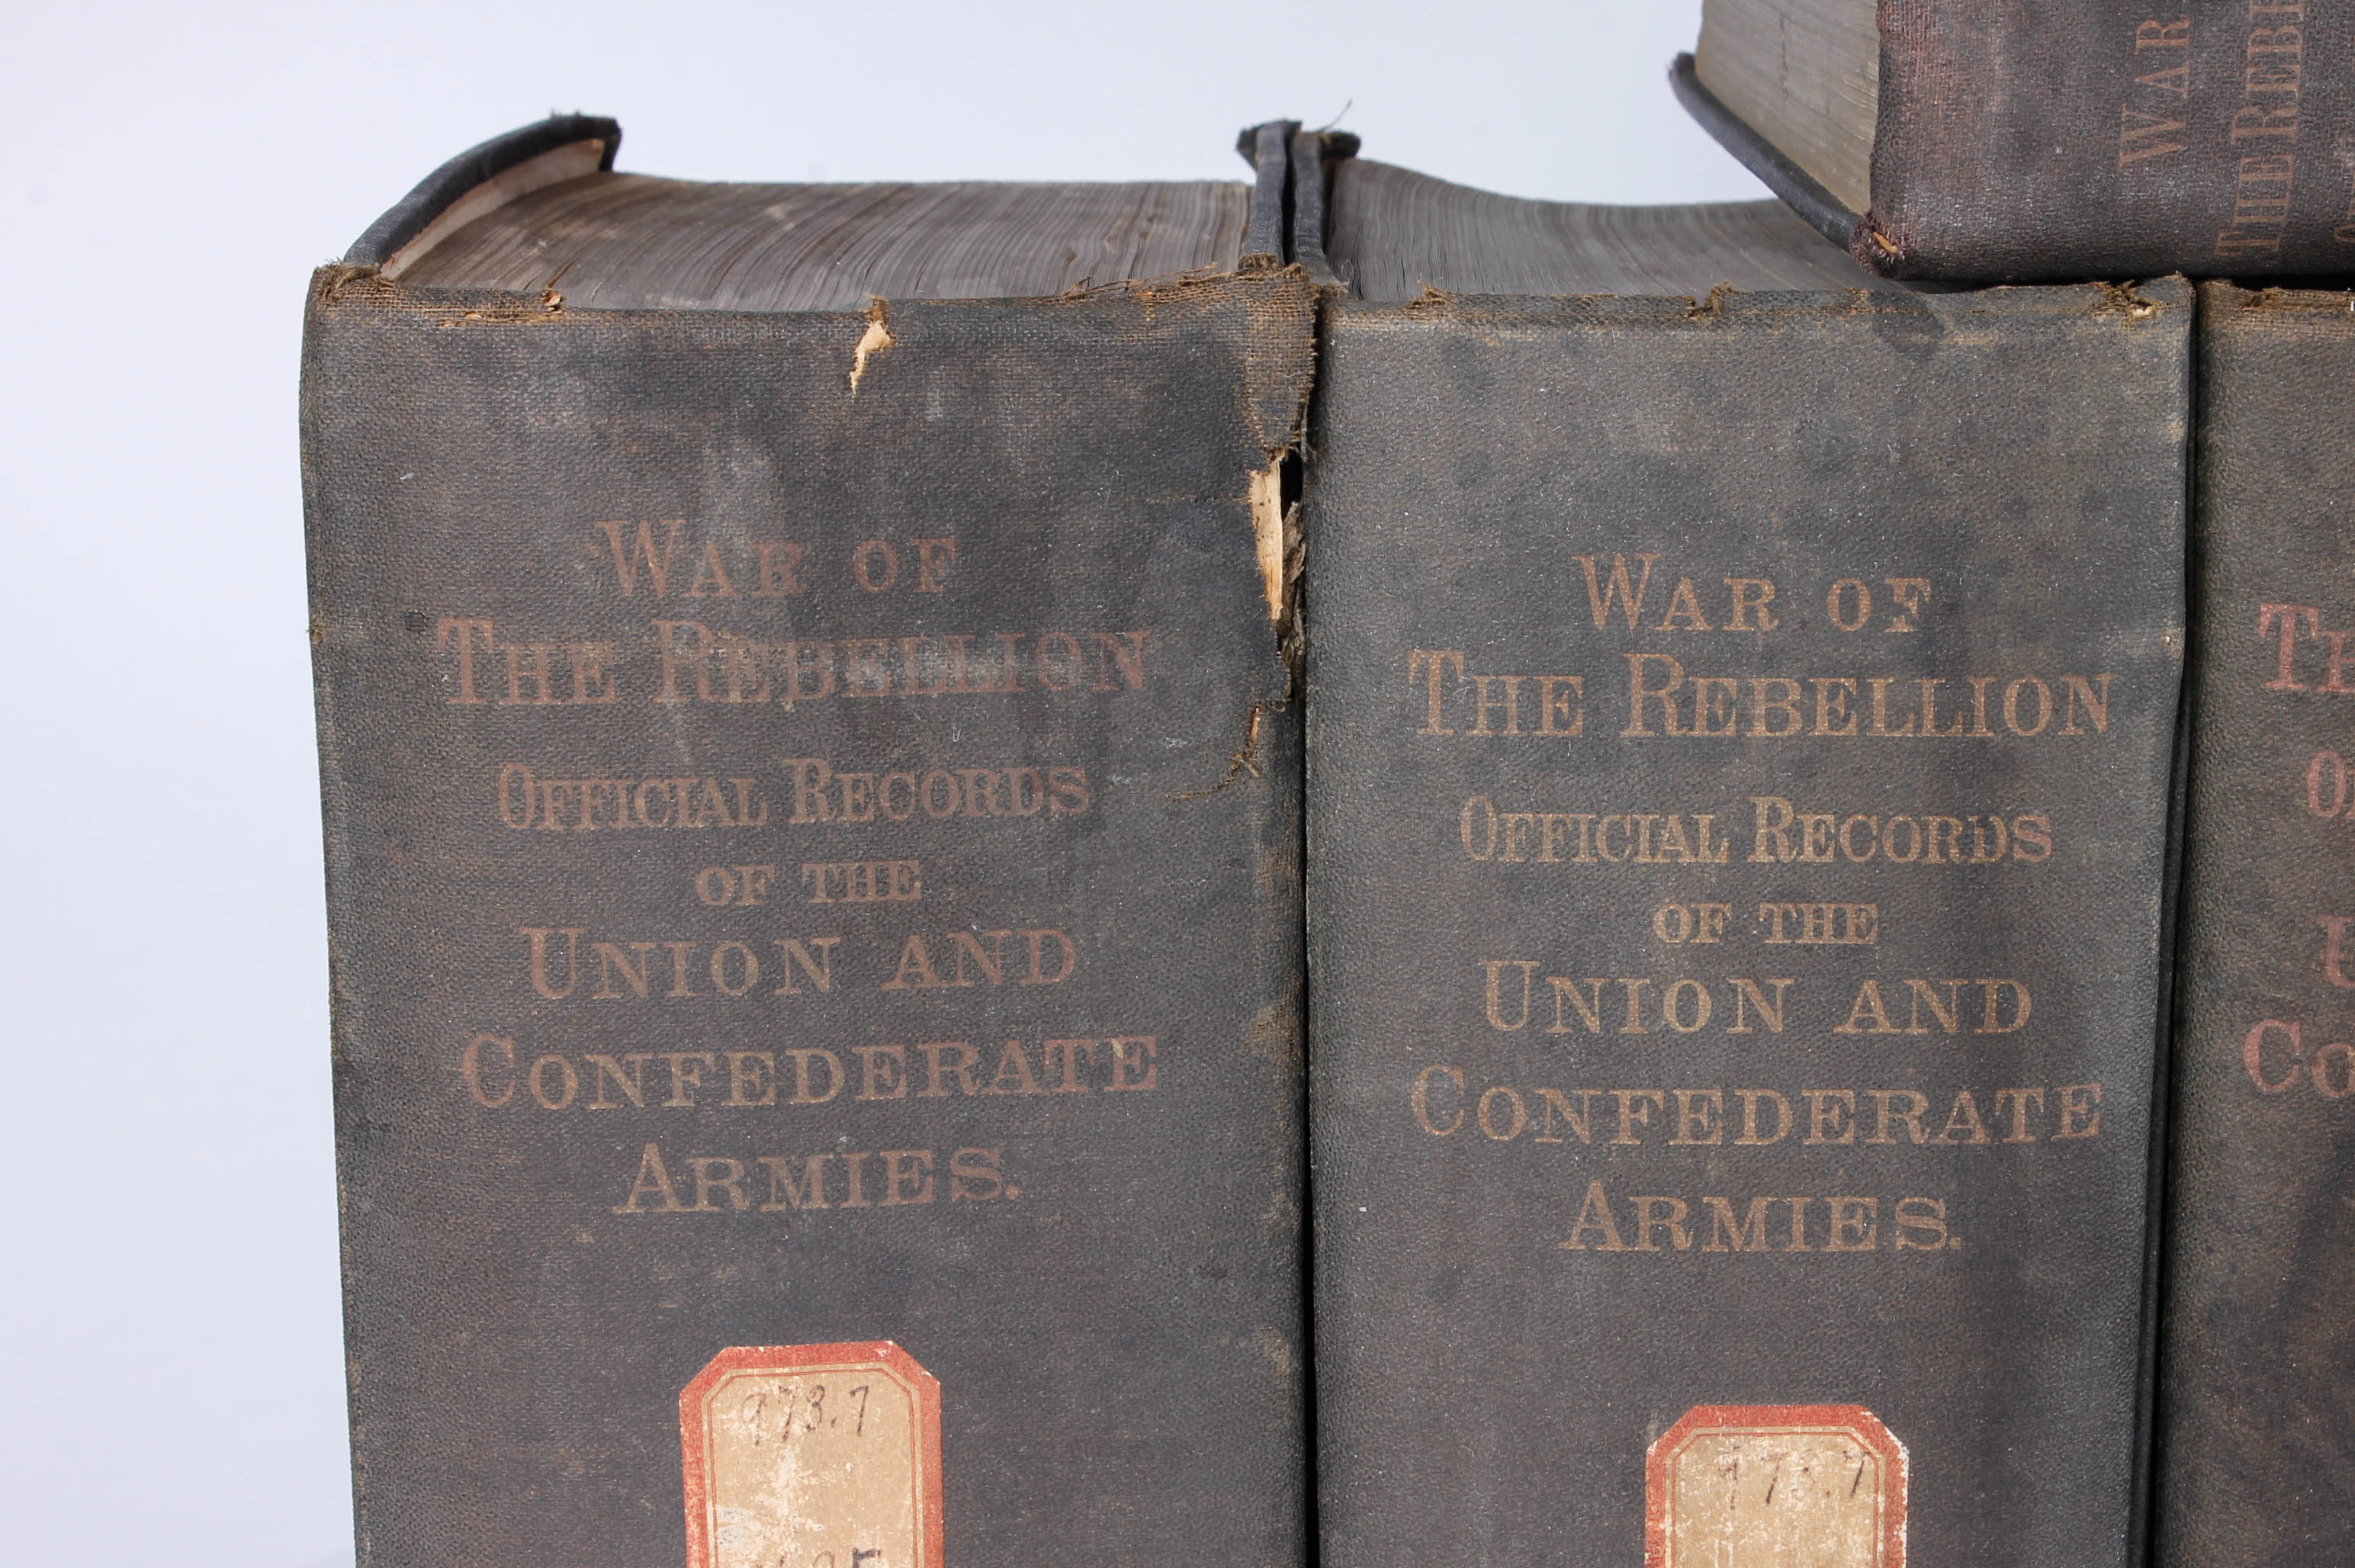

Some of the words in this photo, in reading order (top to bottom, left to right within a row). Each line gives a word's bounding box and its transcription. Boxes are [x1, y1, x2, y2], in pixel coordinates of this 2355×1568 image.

[2117, 14, 2191, 175] WAR
[2215, 153, 2296, 256] THE
[853, 536, 958, 594] OF
[1573, 553, 1779, 632] WAR
[1827, 577, 1933, 632] OF
[437, 617, 616, 705] THE
[652, 619, 1151, 705] REBELLION
[1408, 650, 1584, 737] THE
[1619, 653, 2116, 737] REBELLION
[497, 763, 768, 829] OFFICIAL
[784, 758, 1091, 824] RECORDS
[1460, 795, 1730, 863] OFFICIAL
[1746, 796, 2053, 863] RECORDS
[696, 864, 774, 906] OF
[801, 860, 921, 903] THE
[1653, 902, 1731, 944] OF
[1759, 902, 1878, 944] THE
[519, 927, 843, 1000] UNION
[879, 928, 1078, 991] AND
[1481, 960, 1794, 1034] UNION
[1833, 978, 2033, 1035] AND
[461, 1033, 1158, 1110] CONFEDERATE
[1411, 1065, 2103, 1145] CONFEDERATE
